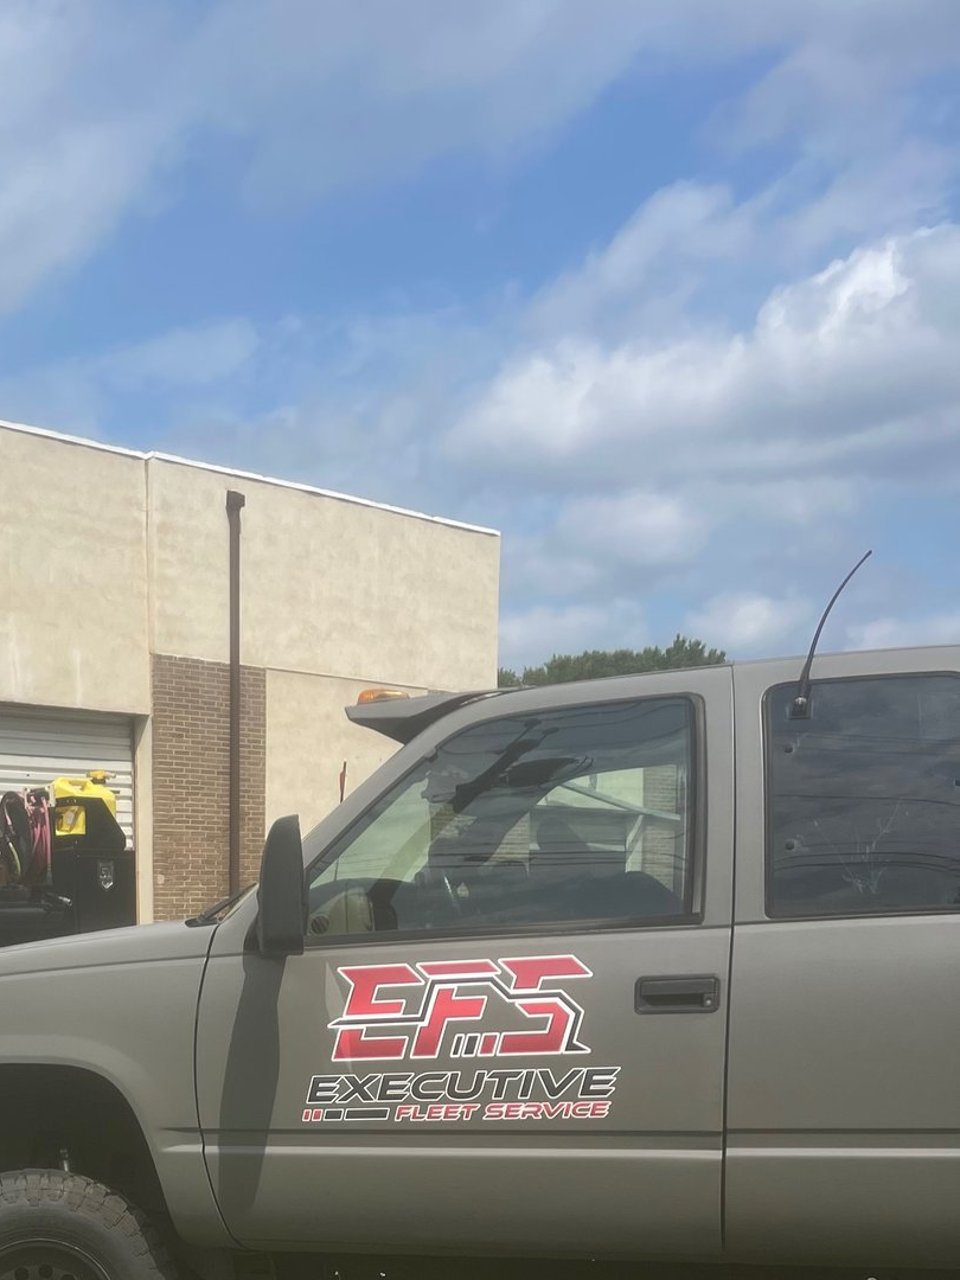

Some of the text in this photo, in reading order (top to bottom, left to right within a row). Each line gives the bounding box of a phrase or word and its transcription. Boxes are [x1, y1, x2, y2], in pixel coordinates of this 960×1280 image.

[328, 954, 593, 1061] EFS
[306, 1066, 621, 1104] EXECUTIVE
[394, 1100, 612, 1122] FLEET SERVICE
